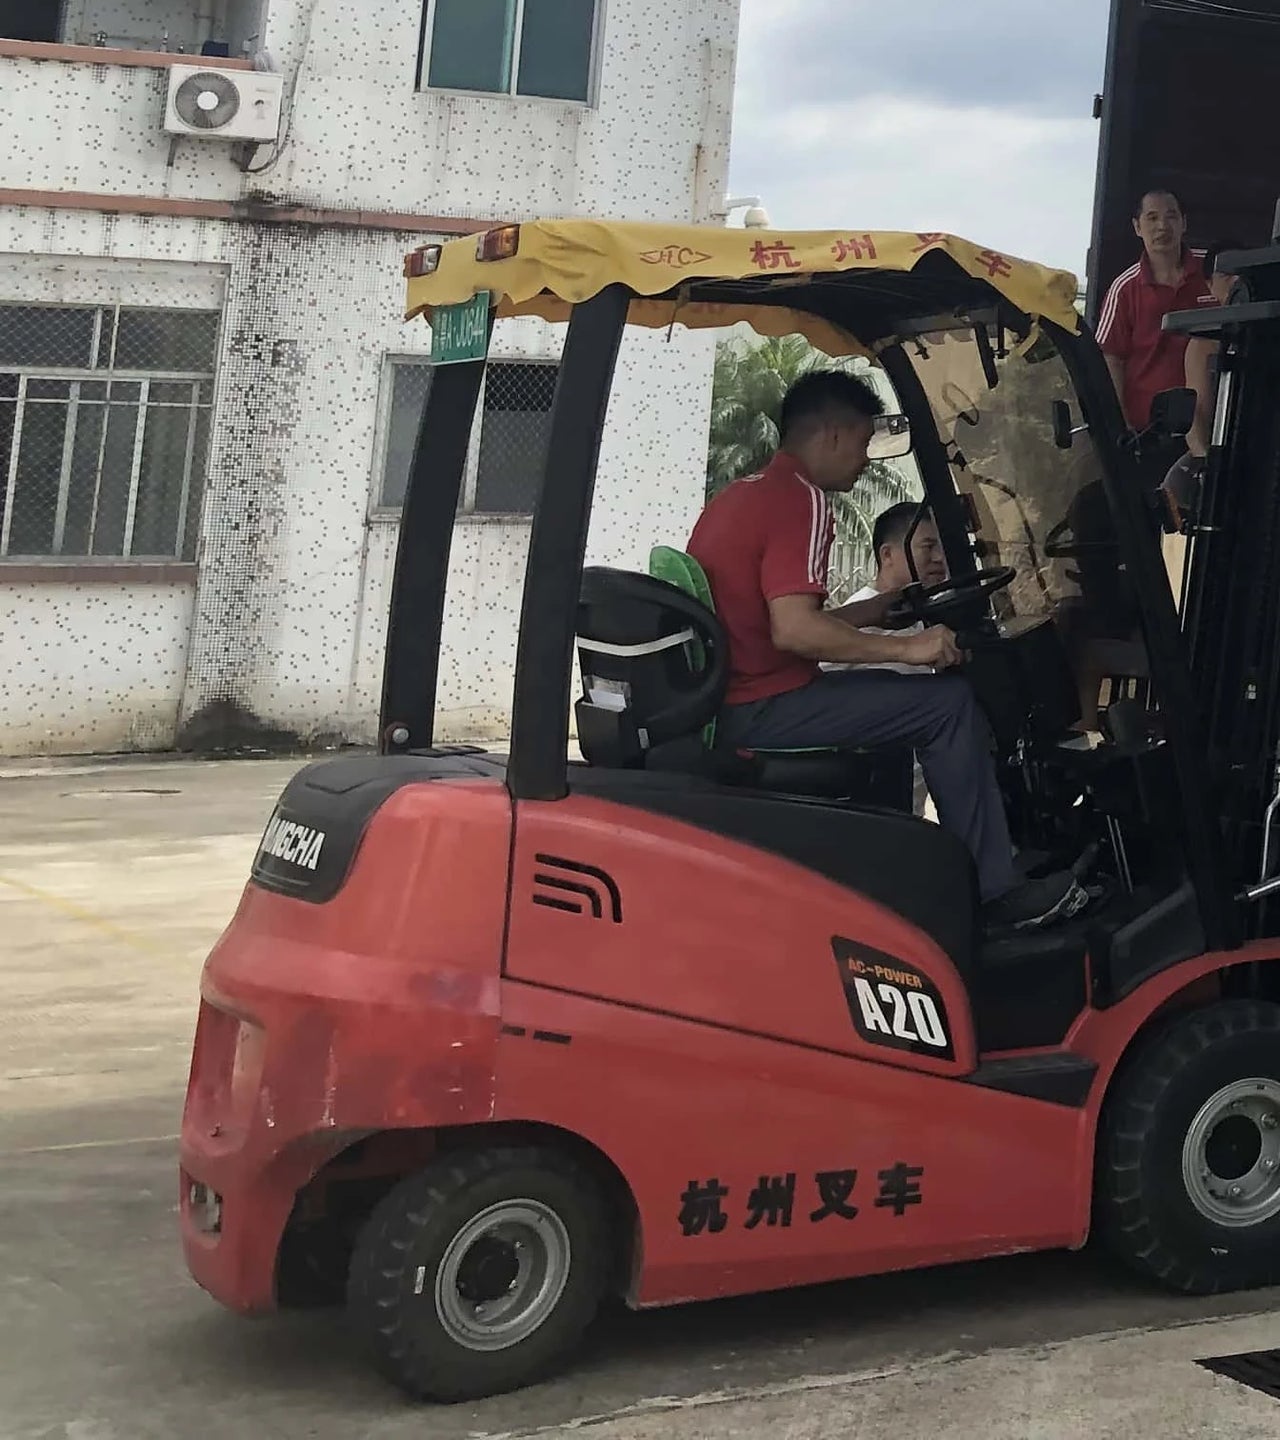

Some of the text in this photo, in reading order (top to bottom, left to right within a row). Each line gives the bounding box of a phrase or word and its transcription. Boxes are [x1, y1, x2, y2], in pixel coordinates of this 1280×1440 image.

[848, 957, 923, 989] AC-POWER
[853, 976, 948, 1048] A20
[677, 1162, 925, 1237] 杭州叉车
